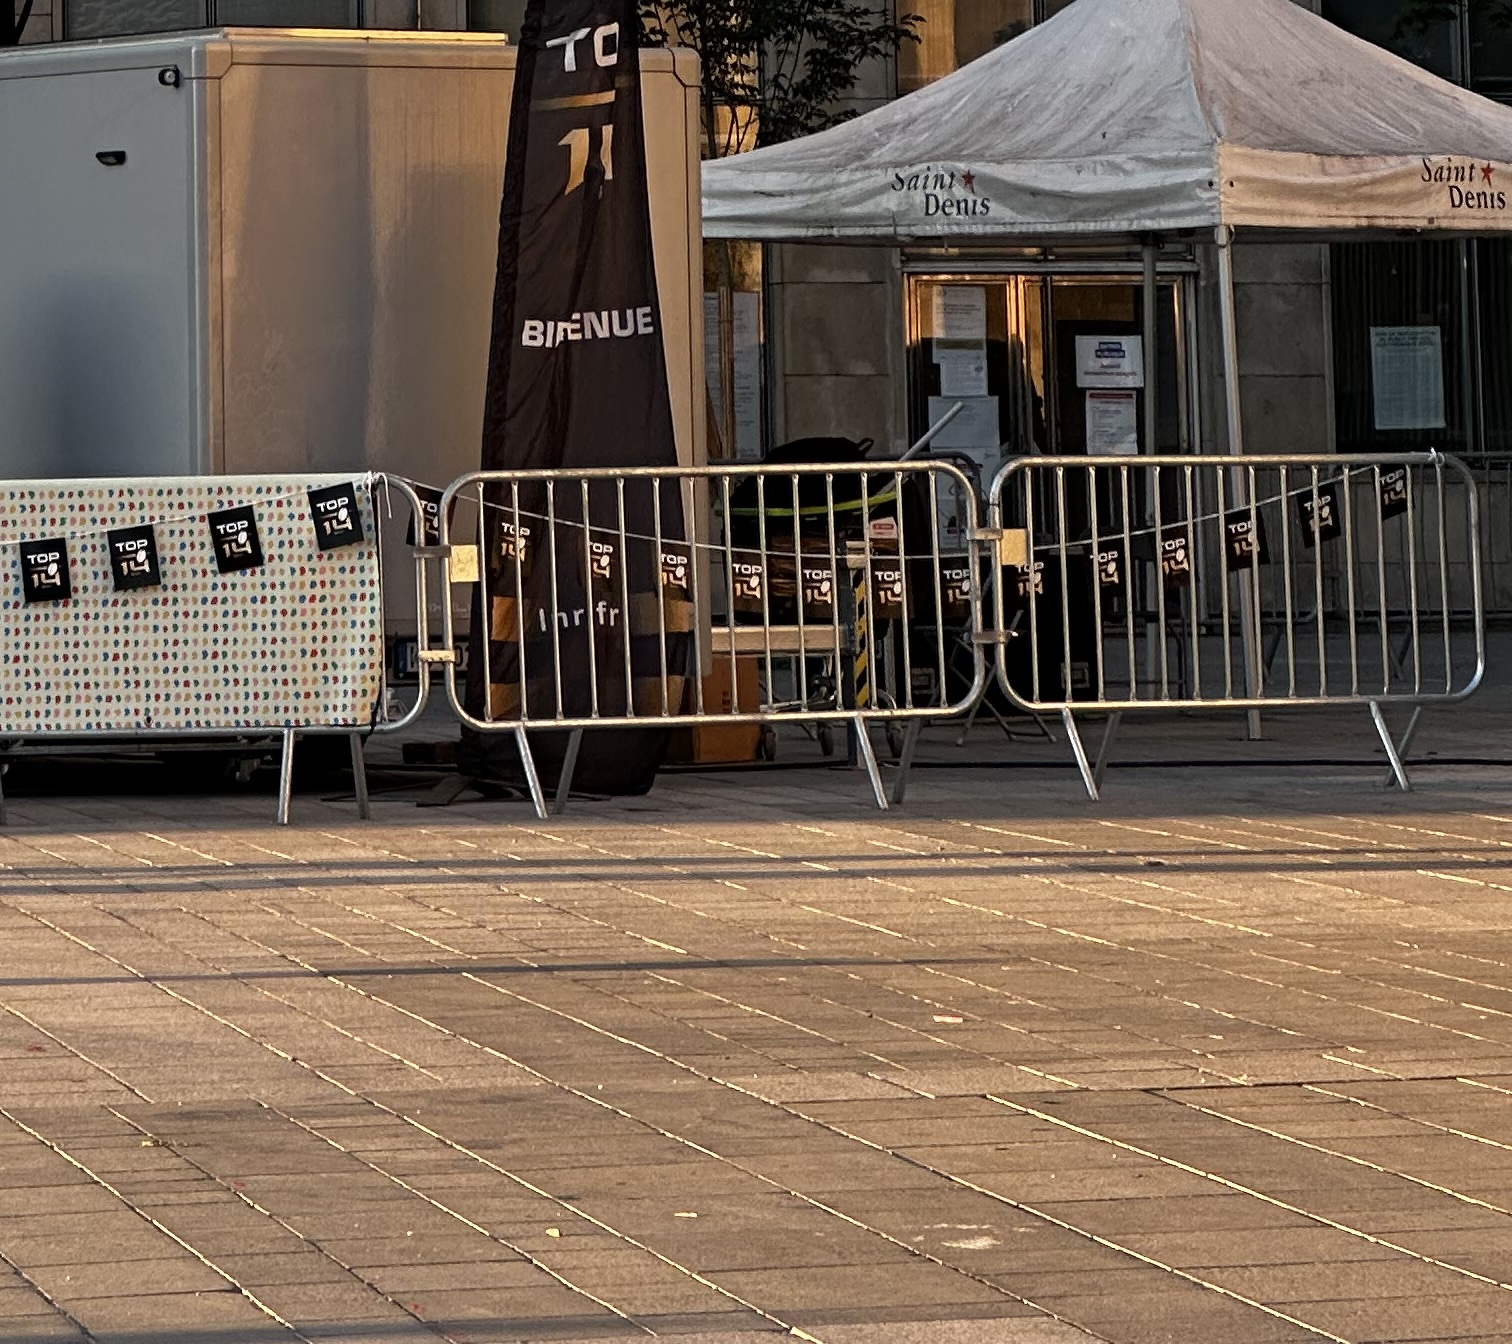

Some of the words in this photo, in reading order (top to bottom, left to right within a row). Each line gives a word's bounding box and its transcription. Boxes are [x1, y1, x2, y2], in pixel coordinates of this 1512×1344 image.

[545, 21, 619, 72] TO
[1421, 157, 1475, 182] Saint
[891, 166, 956, 191] Saint
[925, 193, 990, 216] Denis
[1448, 185, 1506, 209] Denis
[316, 496, 349, 512] TOP
[216, 520, 248, 534] TOP
[323, 513, 353, 535] 14
[115, 539, 148, 552] TOP
[222, 541, 252, 558] 14
[27, 552, 60, 564] TOP
[120, 559, 150, 576] 14
[733, 564, 762, 574] TOP
[31, 573, 61, 588] 14
[735, 583, 761, 599] 14
